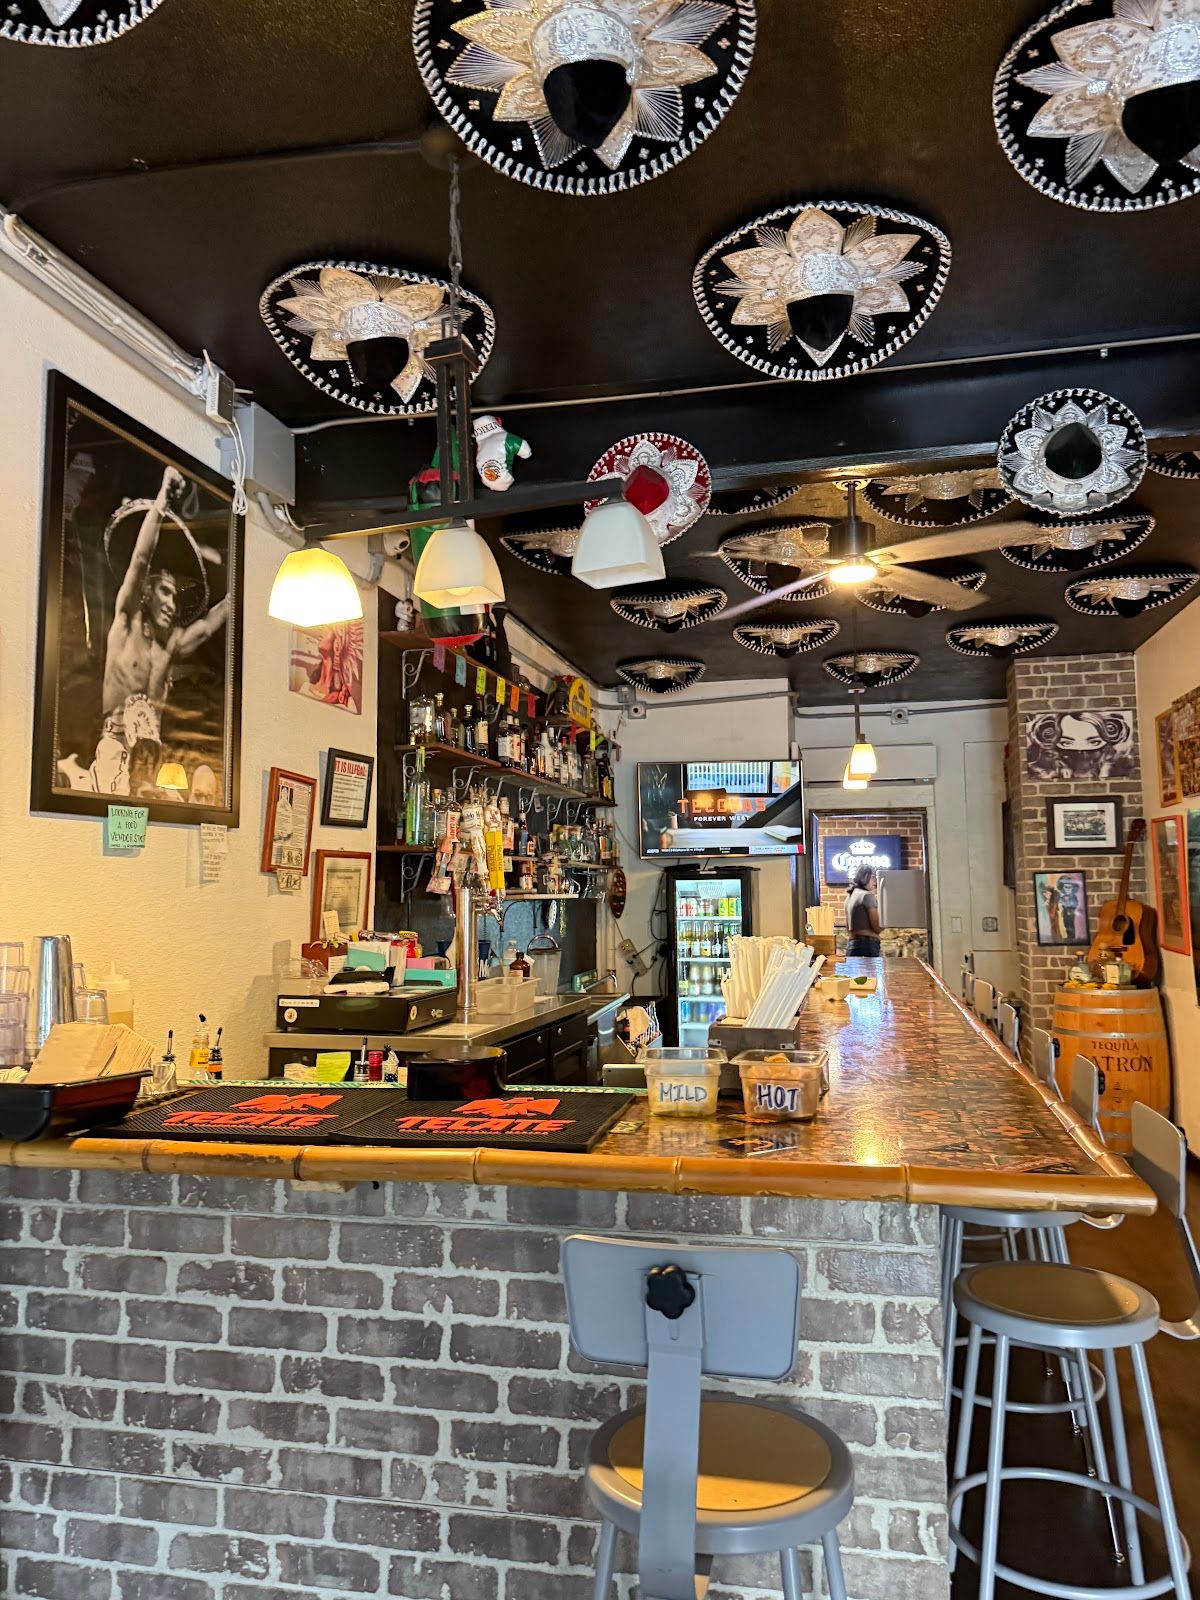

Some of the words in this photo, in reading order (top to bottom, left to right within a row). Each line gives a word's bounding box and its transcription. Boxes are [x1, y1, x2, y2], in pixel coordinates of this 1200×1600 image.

[134, 810, 145, 819] FOR
[831, 851, 892, 871] Corona
[1091, 1039, 1139, 1051] TEQUILA
[659, 1082, 708, 1103] MILD
[756, 1083, 799, 1111] HOT
[163, 1111, 339, 1127] TECATE
[395, 1116, 577, 1132] TECATE
